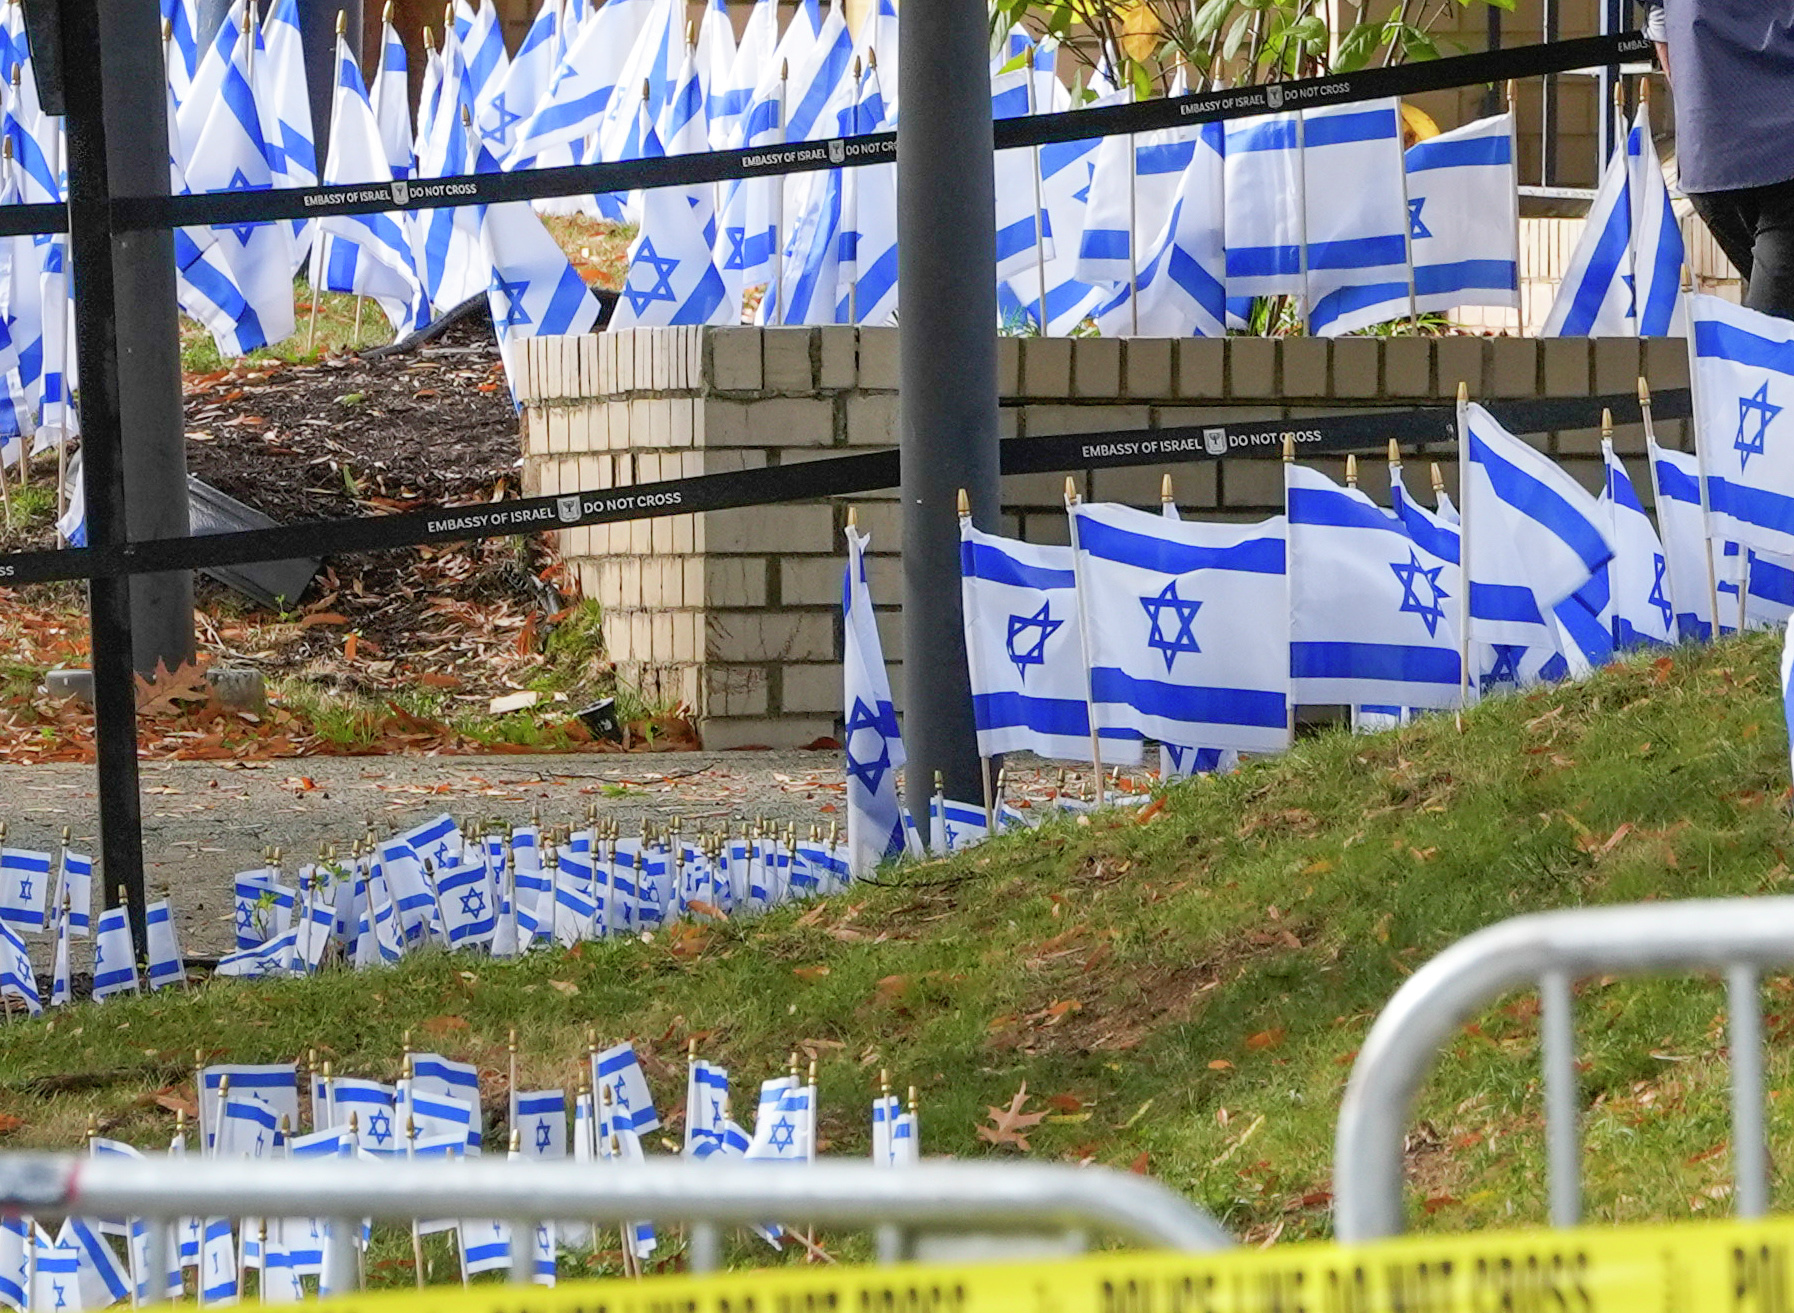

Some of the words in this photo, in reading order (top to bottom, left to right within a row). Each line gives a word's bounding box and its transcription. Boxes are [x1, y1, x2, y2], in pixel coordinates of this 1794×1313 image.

[1180, 99, 1222, 116] EMBASSY
[1221, 97, 1234, 110] OF
[1234, 94, 1266, 107] ISRAEL
[1284, 90, 1299, 101] DO
[1300, 86, 1321, 99] NOT
[1321, 82, 1351, 96] CROSS
[742, 152, 785, 168] EMBASSY
[783, 150, 797, 163] OF
[797, 147, 828, 162] ISRAEL
[845, 144, 860, 156] DO
[860, 142, 881, 155] NOT
[303, 194, 347, 207] EMBASSY
[345, 193, 359, 204] OF
[358, 189, 392, 203] ISRAEL
[409, 187, 427, 199] DO
[426, 185, 446, 197] NOT
[444, 183, 478, 196] CROSS
[1082, 441, 1139, 458] EMBASSY
[1140, 440, 1159, 454] OF
[1160, 437, 1203, 453] ISRAEL
[1229, 434, 1249, 448] DO
[1250, 432, 1279, 446] NOT
[1279, 429, 1323, 445] CROSS
[427, 515, 488, 533] EMBASSY
[490, 512, 509, 525] OF
[510, 507, 556, 524] ISRAEL
[583, 501, 604, 514] DO
[606, 496, 636, 511] NOT
[636, 491, 683, 508] CROSS
